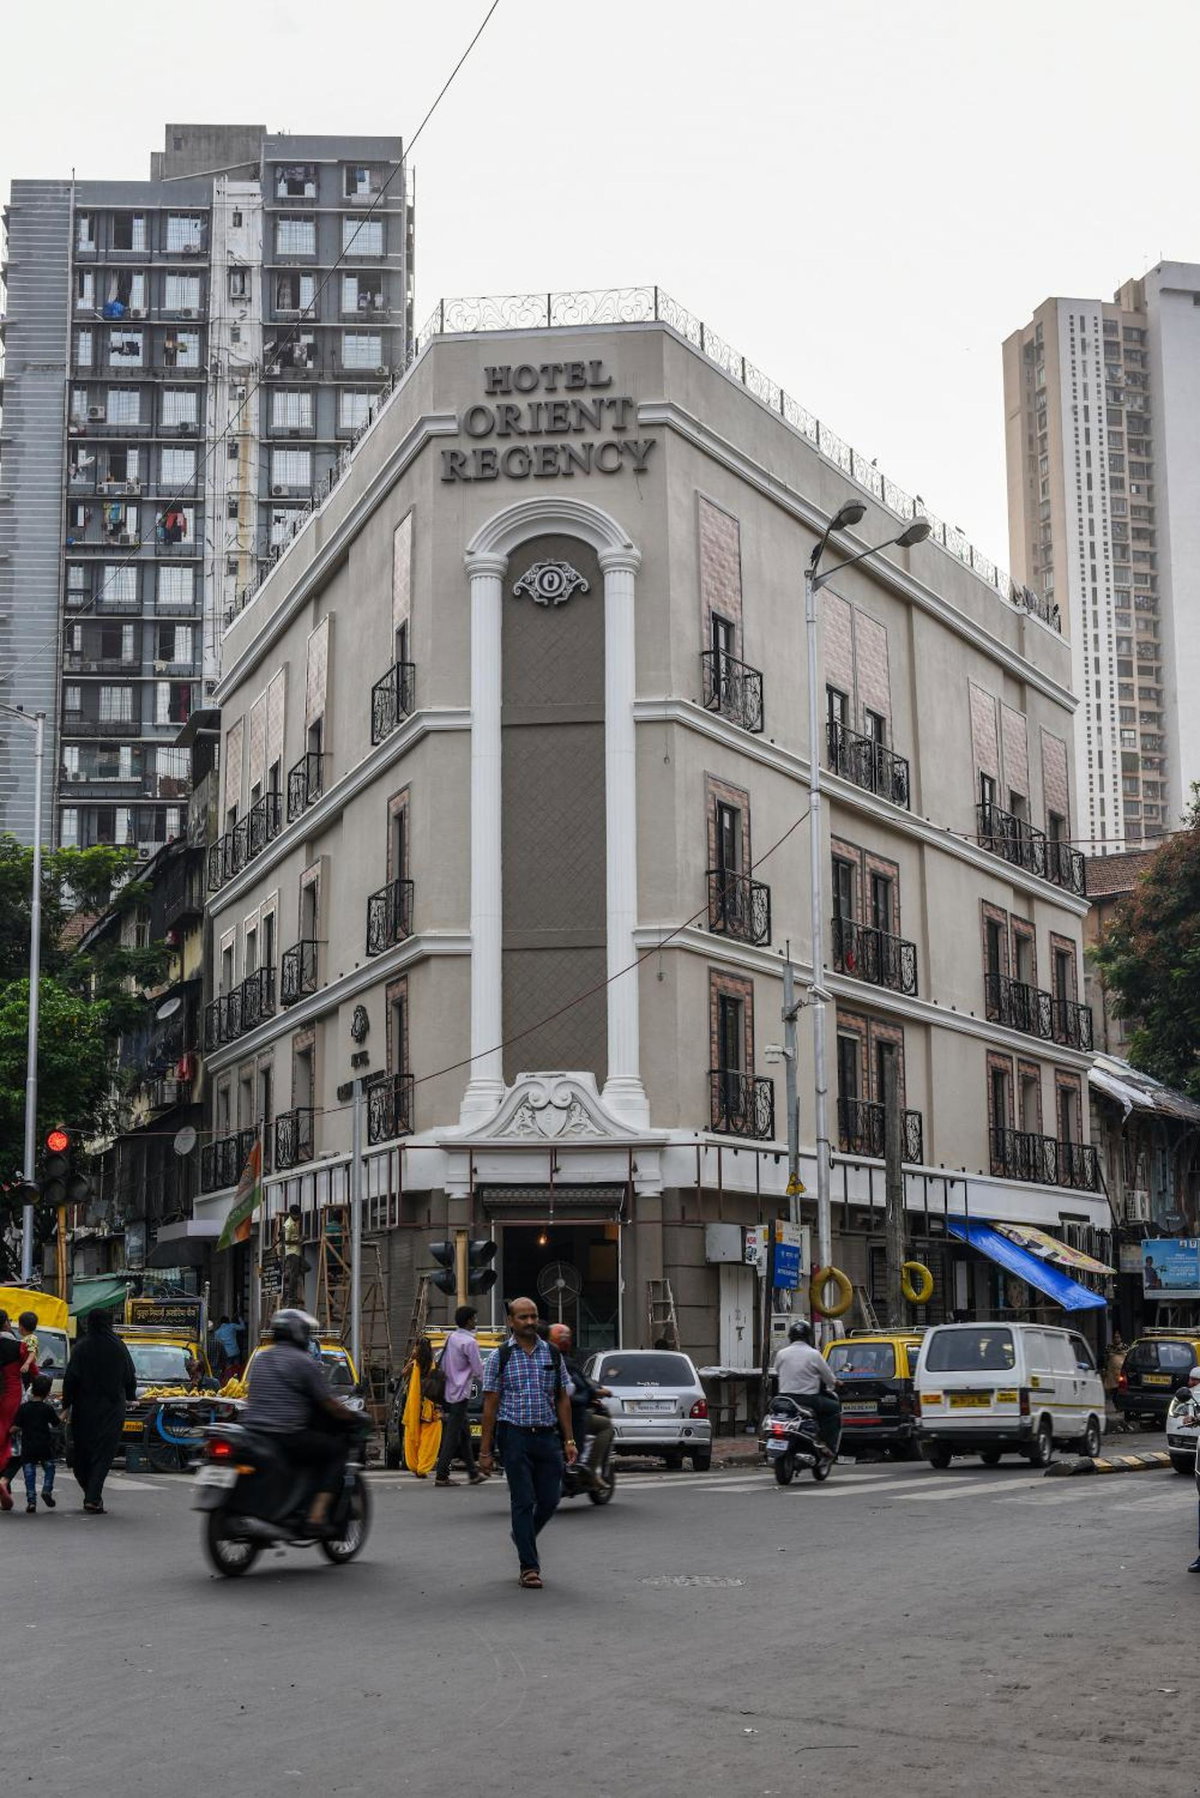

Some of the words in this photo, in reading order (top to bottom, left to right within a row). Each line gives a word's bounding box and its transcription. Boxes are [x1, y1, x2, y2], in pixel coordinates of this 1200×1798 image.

[484, 360, 612, 394] HOTEL
[463, 397, 633, 436] ORIENT
[441, 439, 656, 481] REGENCY
